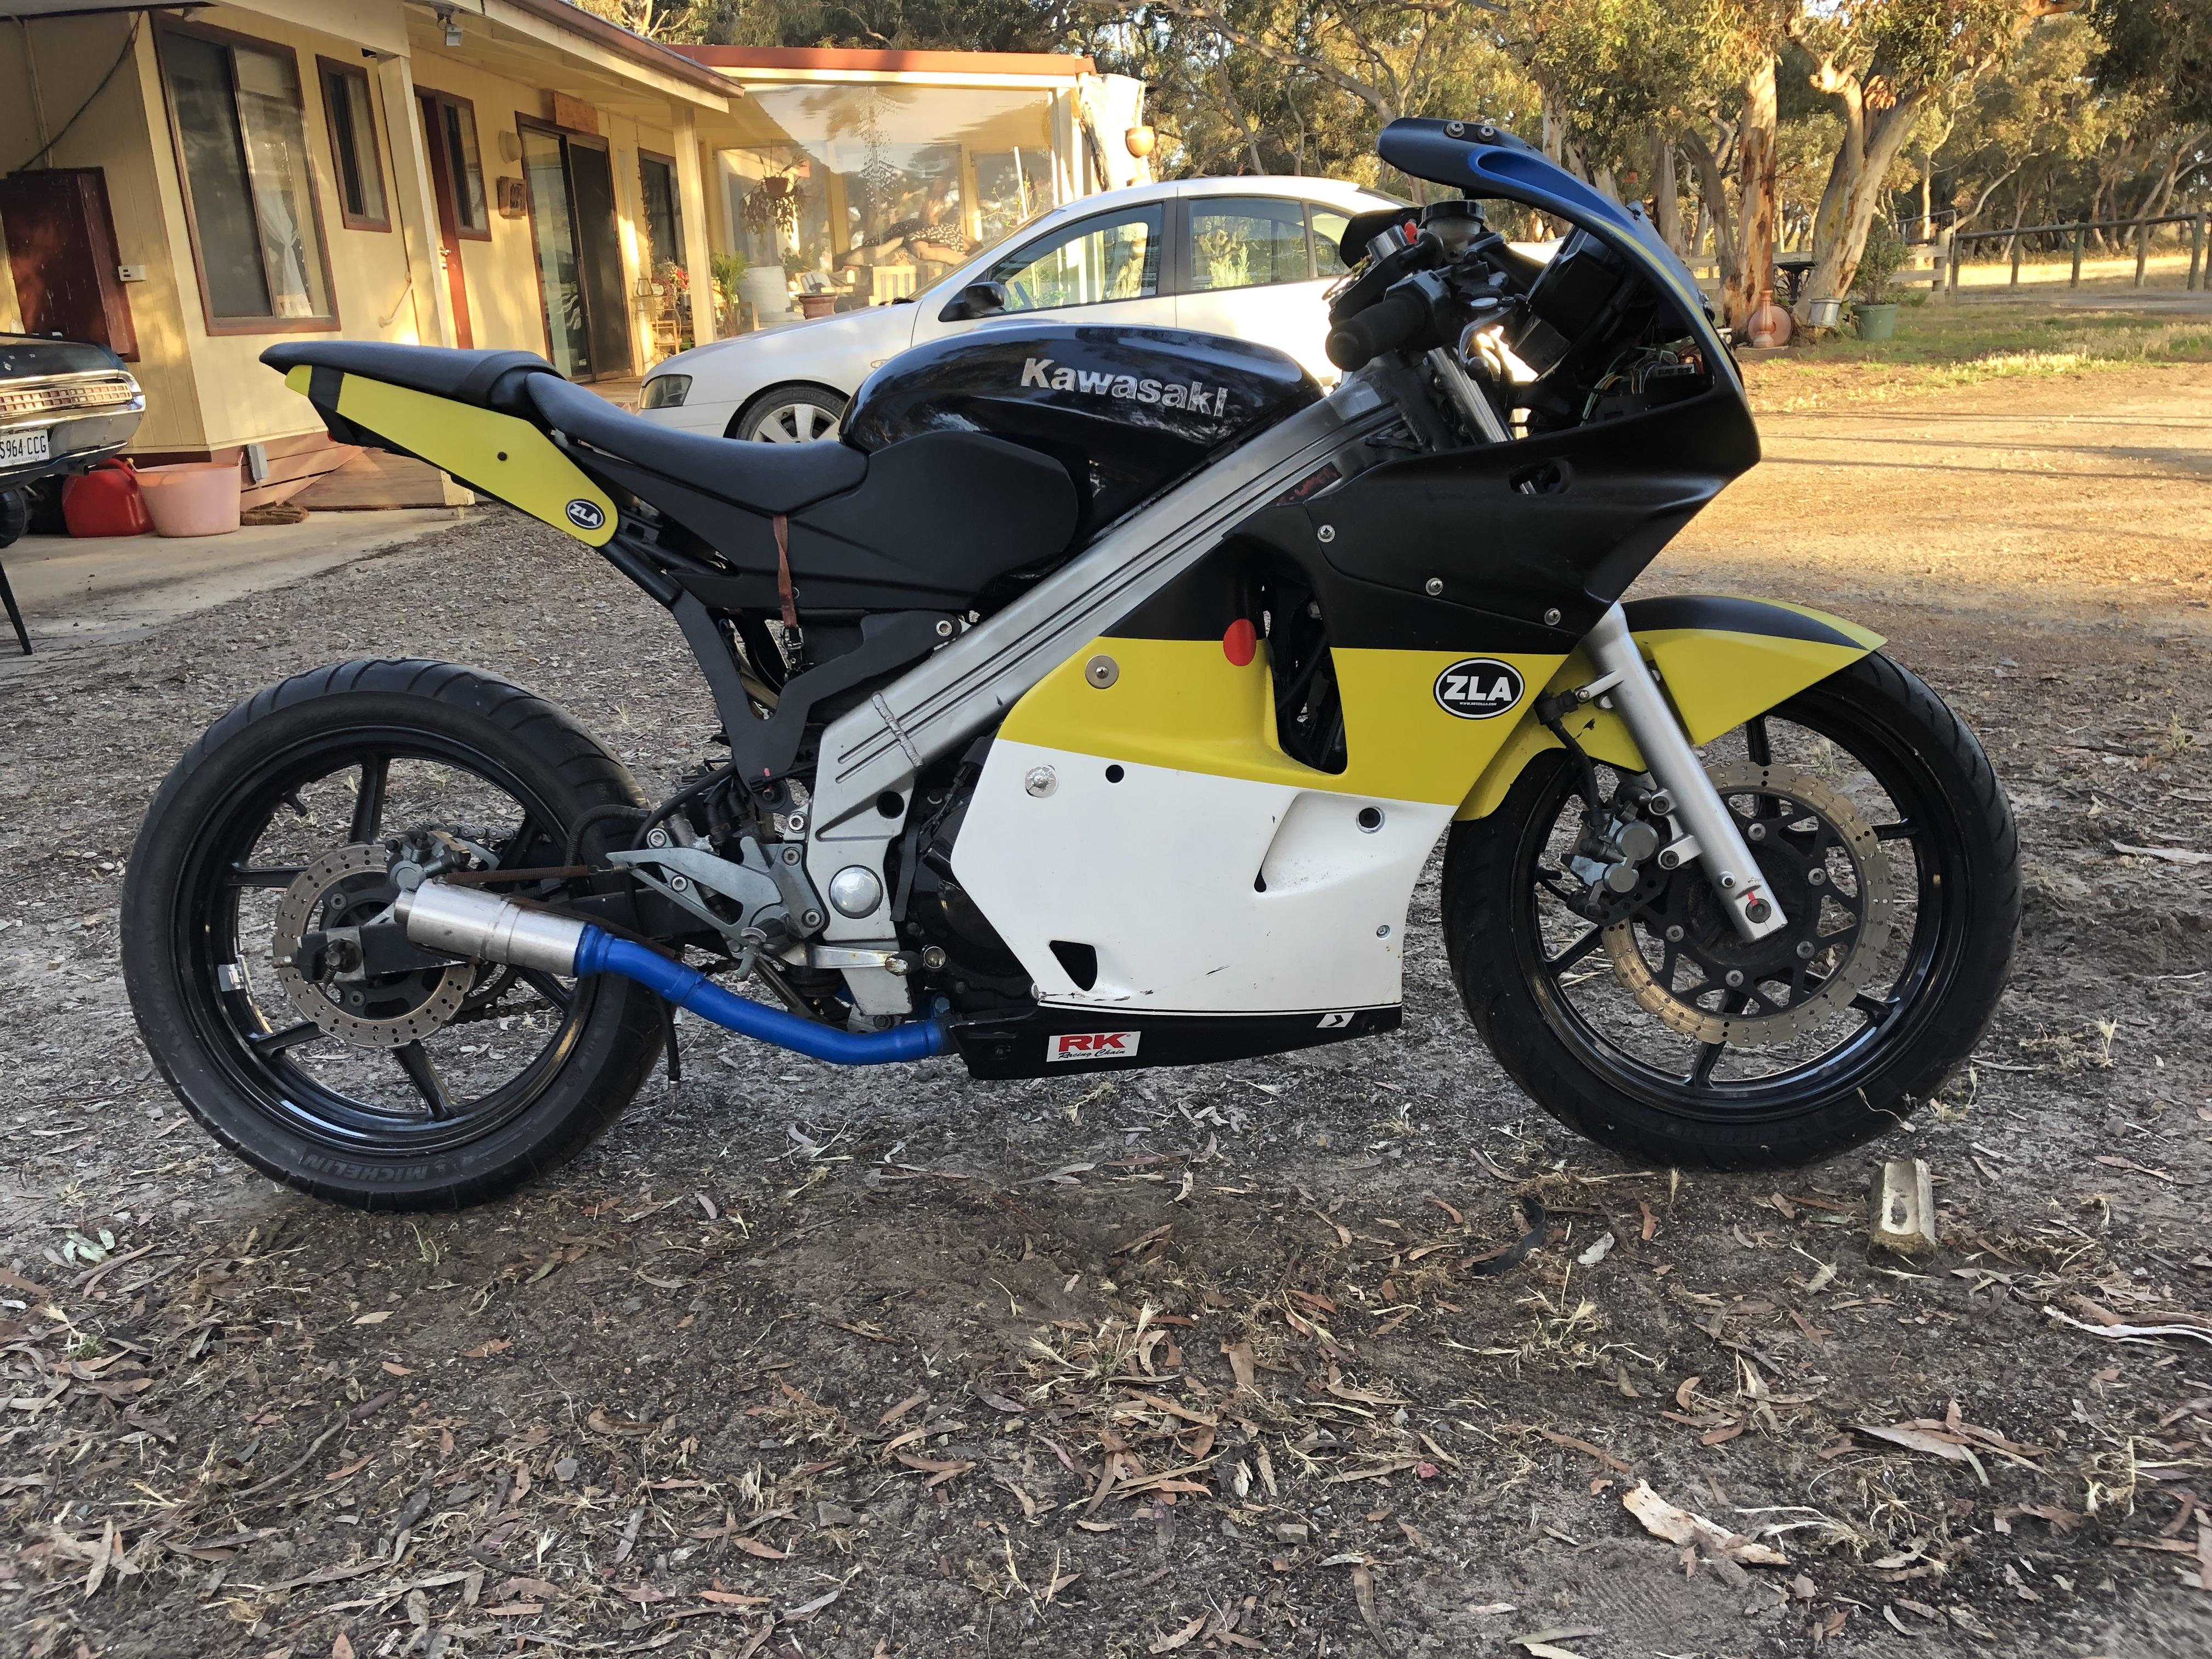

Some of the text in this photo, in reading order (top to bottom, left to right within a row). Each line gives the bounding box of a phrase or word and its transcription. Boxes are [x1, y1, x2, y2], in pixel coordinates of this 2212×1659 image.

[1020, 358, 1228, 417] Kawasaki
[0, 436, 46, 459] S964 CCG
[570, 504, 597, 525] ZLA
[1443, 675, 1512, 701] ZLA
[1058, 1034, 1128, 1052] RK
[1094, 1049, 1126, 1057] Chain
[303, 1153, 428, 1180] MICHELIN
